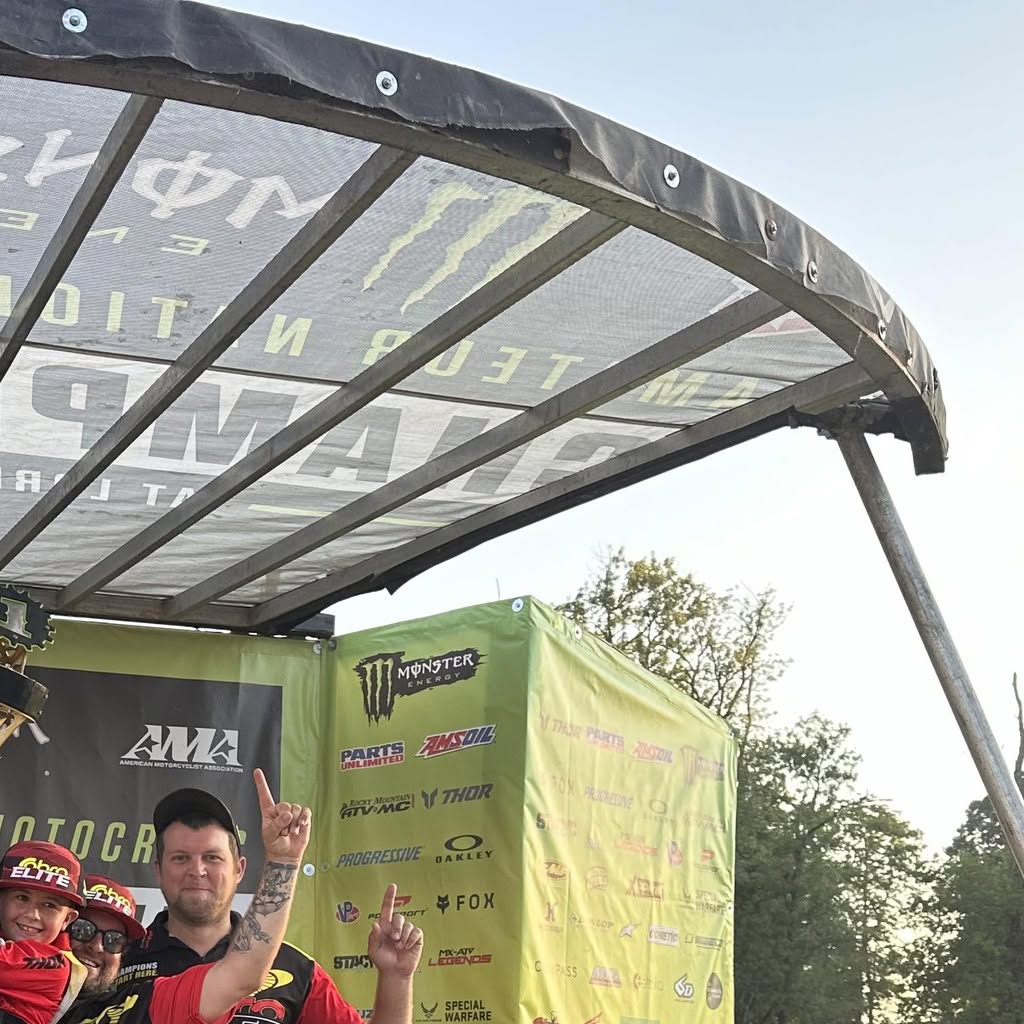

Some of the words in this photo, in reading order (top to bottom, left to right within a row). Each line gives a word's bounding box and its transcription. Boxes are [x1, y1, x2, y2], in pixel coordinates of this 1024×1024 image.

[398, 652, 475, 681] MONSTER
[408, 671, 461, 688] ENERGY
[120, 724, 244, 767] AMA
[420, 725, 497, 756] AMSOIL
[341, 742, 404, 763] PARTS
[341, 754, 404, 770] UNLIMITED
[119, 759, 154, 768] AMERICAN
[442, 783, 494, 805] THOR
[336, 846, 423, 868] PROGRESSIVE
[435, 850, 493, 864] OAKLEY
[10, 866, 71, 888] ELITE
[85, 889, 133, 917] ELITE
[456, 892, 495, 911] FOX
[336, 901, 352, 923] VP
[428, 954, 493, 967] LEGENDS
[439, 947, 475, 957] MX-ATV
[445, 1000, 485, 1011] SPECIAL
[444, 1011, 492, 1022] WARFARE
